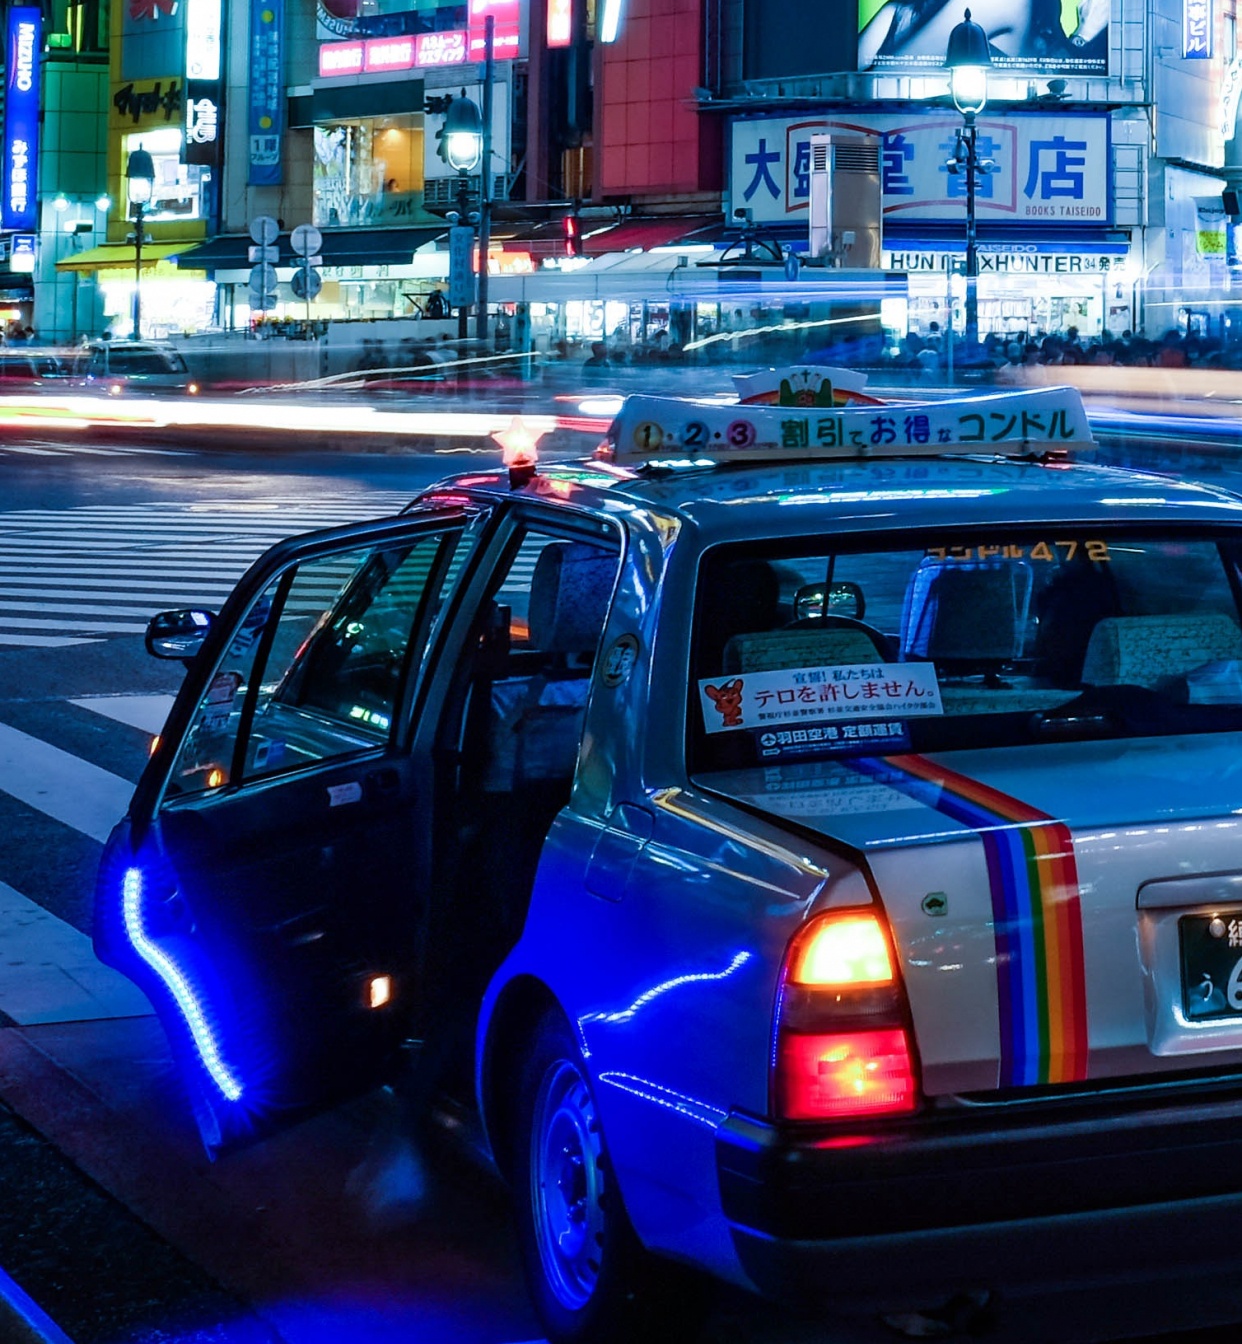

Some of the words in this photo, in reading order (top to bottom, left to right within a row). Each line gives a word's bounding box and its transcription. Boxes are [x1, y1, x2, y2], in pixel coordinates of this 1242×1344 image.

[17, 22, 35, 92] MIZUHO
[1025, 206, 1056, 216] BOOKS
[1060, 206, 1102, 217] TAISEIDO
[832, 667, 885, 683] 私たちは
[754, 679, 935, 708] テロを許しません。
[776, 726, 839, 745] 羽田空港
